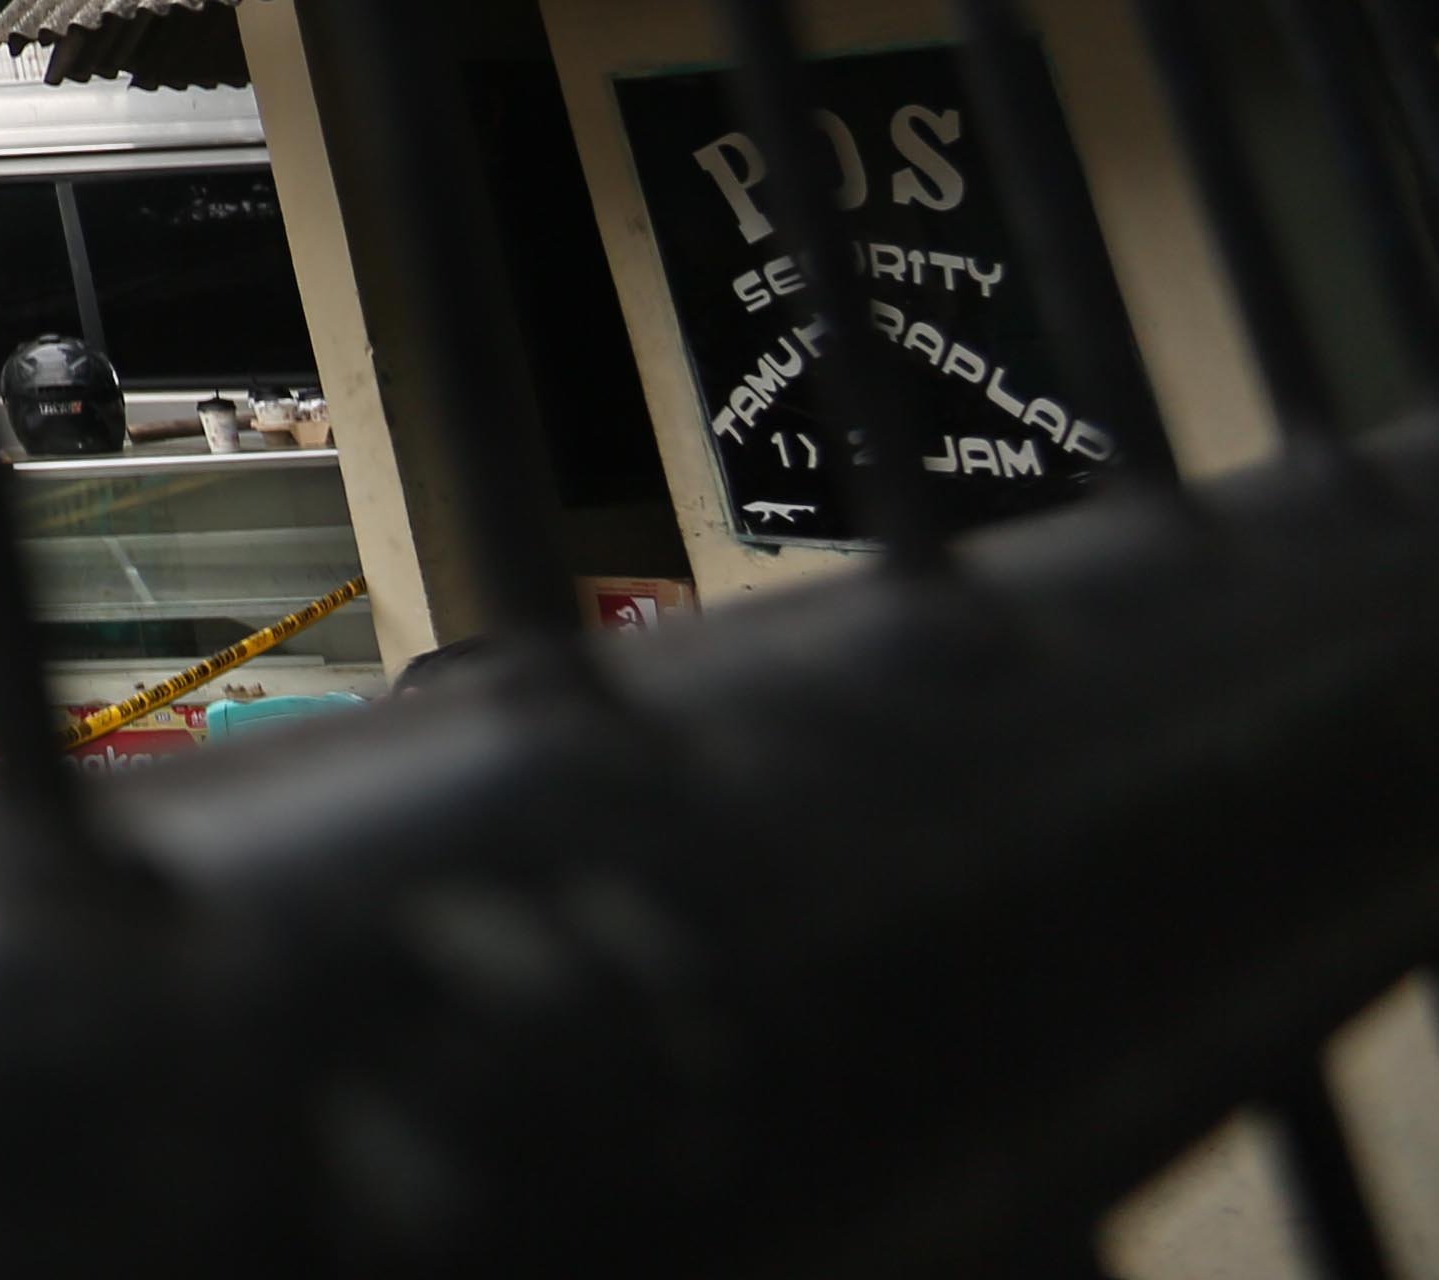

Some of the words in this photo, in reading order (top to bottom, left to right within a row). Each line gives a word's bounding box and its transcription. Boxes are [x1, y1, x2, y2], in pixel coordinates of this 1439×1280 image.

[731, 241, 1003, 312] SERITY
[711, 335, 805, 446] TAMU
[792, 296, 987, 385] HRAP
[921, 434, 1044, 479] JAM
